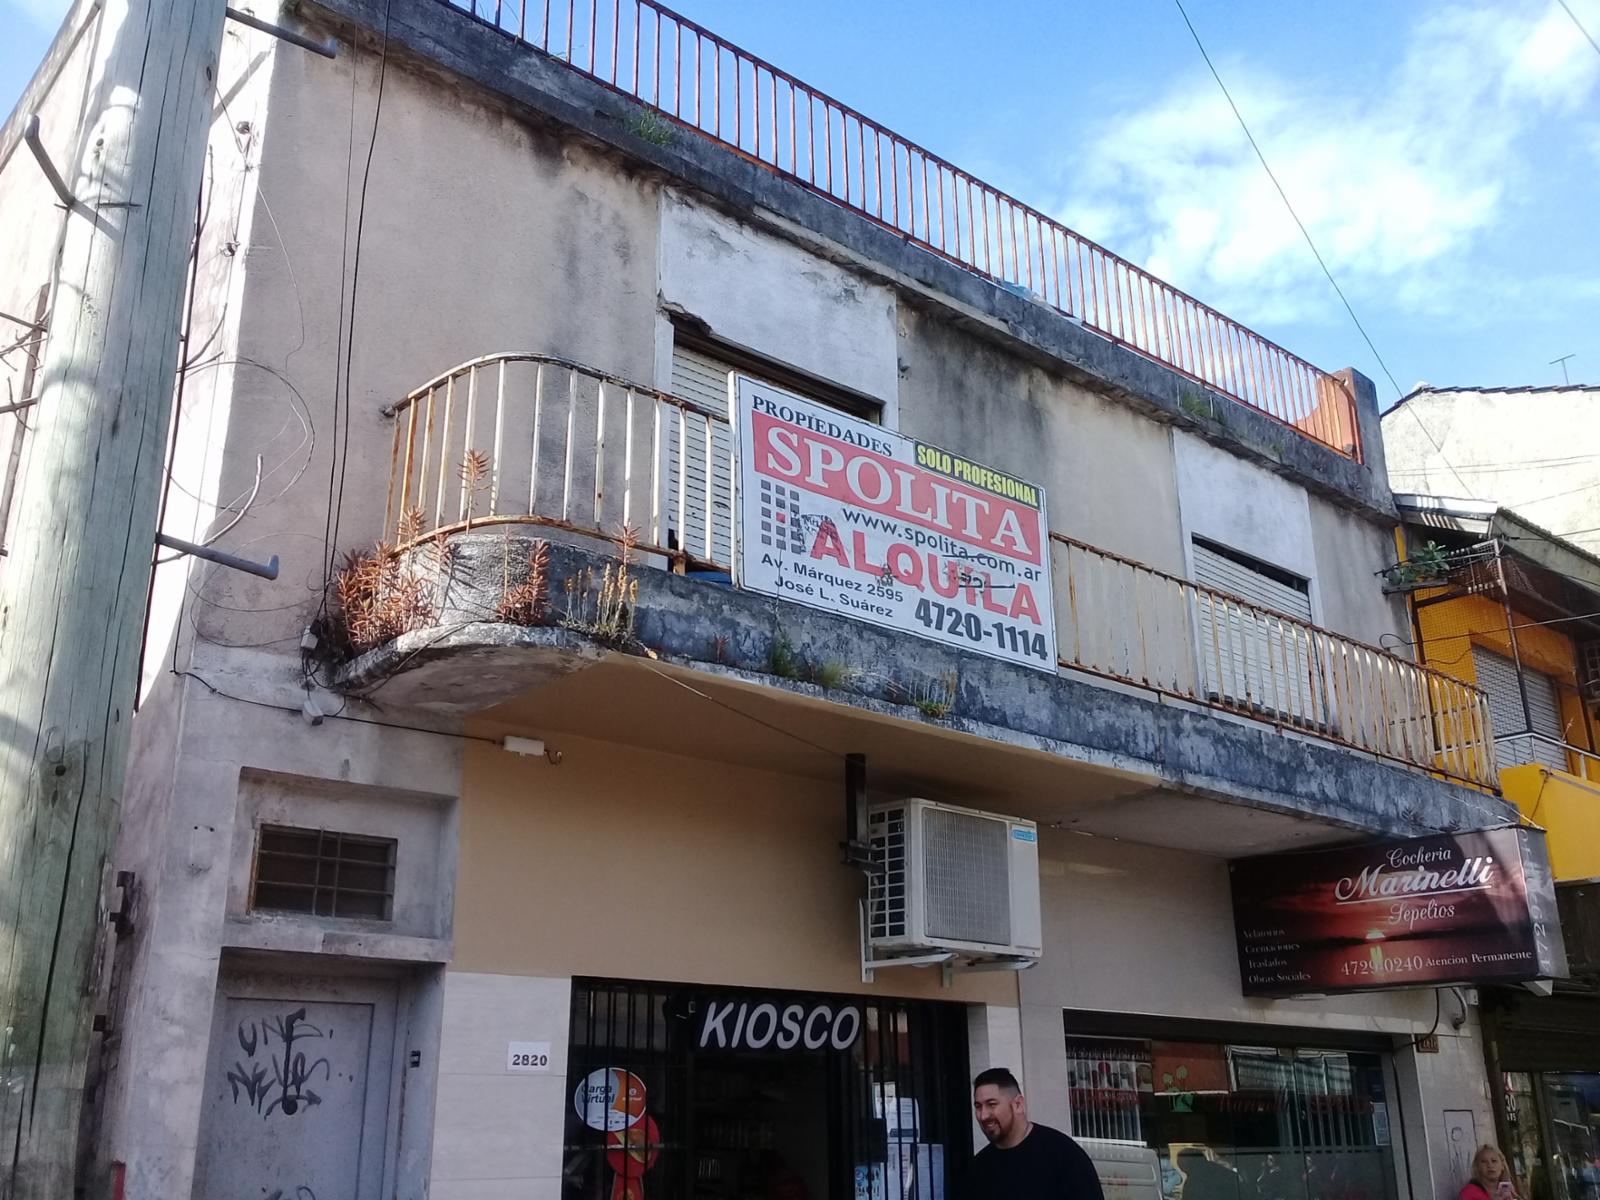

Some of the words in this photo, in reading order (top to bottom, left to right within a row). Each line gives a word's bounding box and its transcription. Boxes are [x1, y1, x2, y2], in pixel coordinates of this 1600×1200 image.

[752, 394, 893, 457] PROPIEDADES
[767, 427, 1033, 556] SPOLITA
[917, 445, 951, 474] SOLO
[954, 456, 1039, 507] PROFESIONAL
[843, 507, 1042, 583] www.spolita.com.ar
[761, 553, 789, 571] Av.
[794, 562, 863, 594] Márquez
[867, 583, 904, 603] 2595
[774, 576, 814, 596] José
[820, 587, 836, 603] L.
[839, 593, 894, 618] Suárez
[810, 521, 1042, 626] ALQUILA
[915, 597, 1048, 661] 4720-1114
[1335, 856, 1494, 901] Marinelli
[1386, 847, 1452, 869] Cocheria
[1388, 902, 1455, 930] Sepelios
[1248, 973, 1276, 984] Obras
[1276, 971, 1312, 982] Sociales
[1425, 953, 1469, 968] Atencion
[1471, 949, 1533, 965] Permanente
[699, 1001, 861, 1051] KIOSCO
[512, 1053, 549, 1067] 2820
